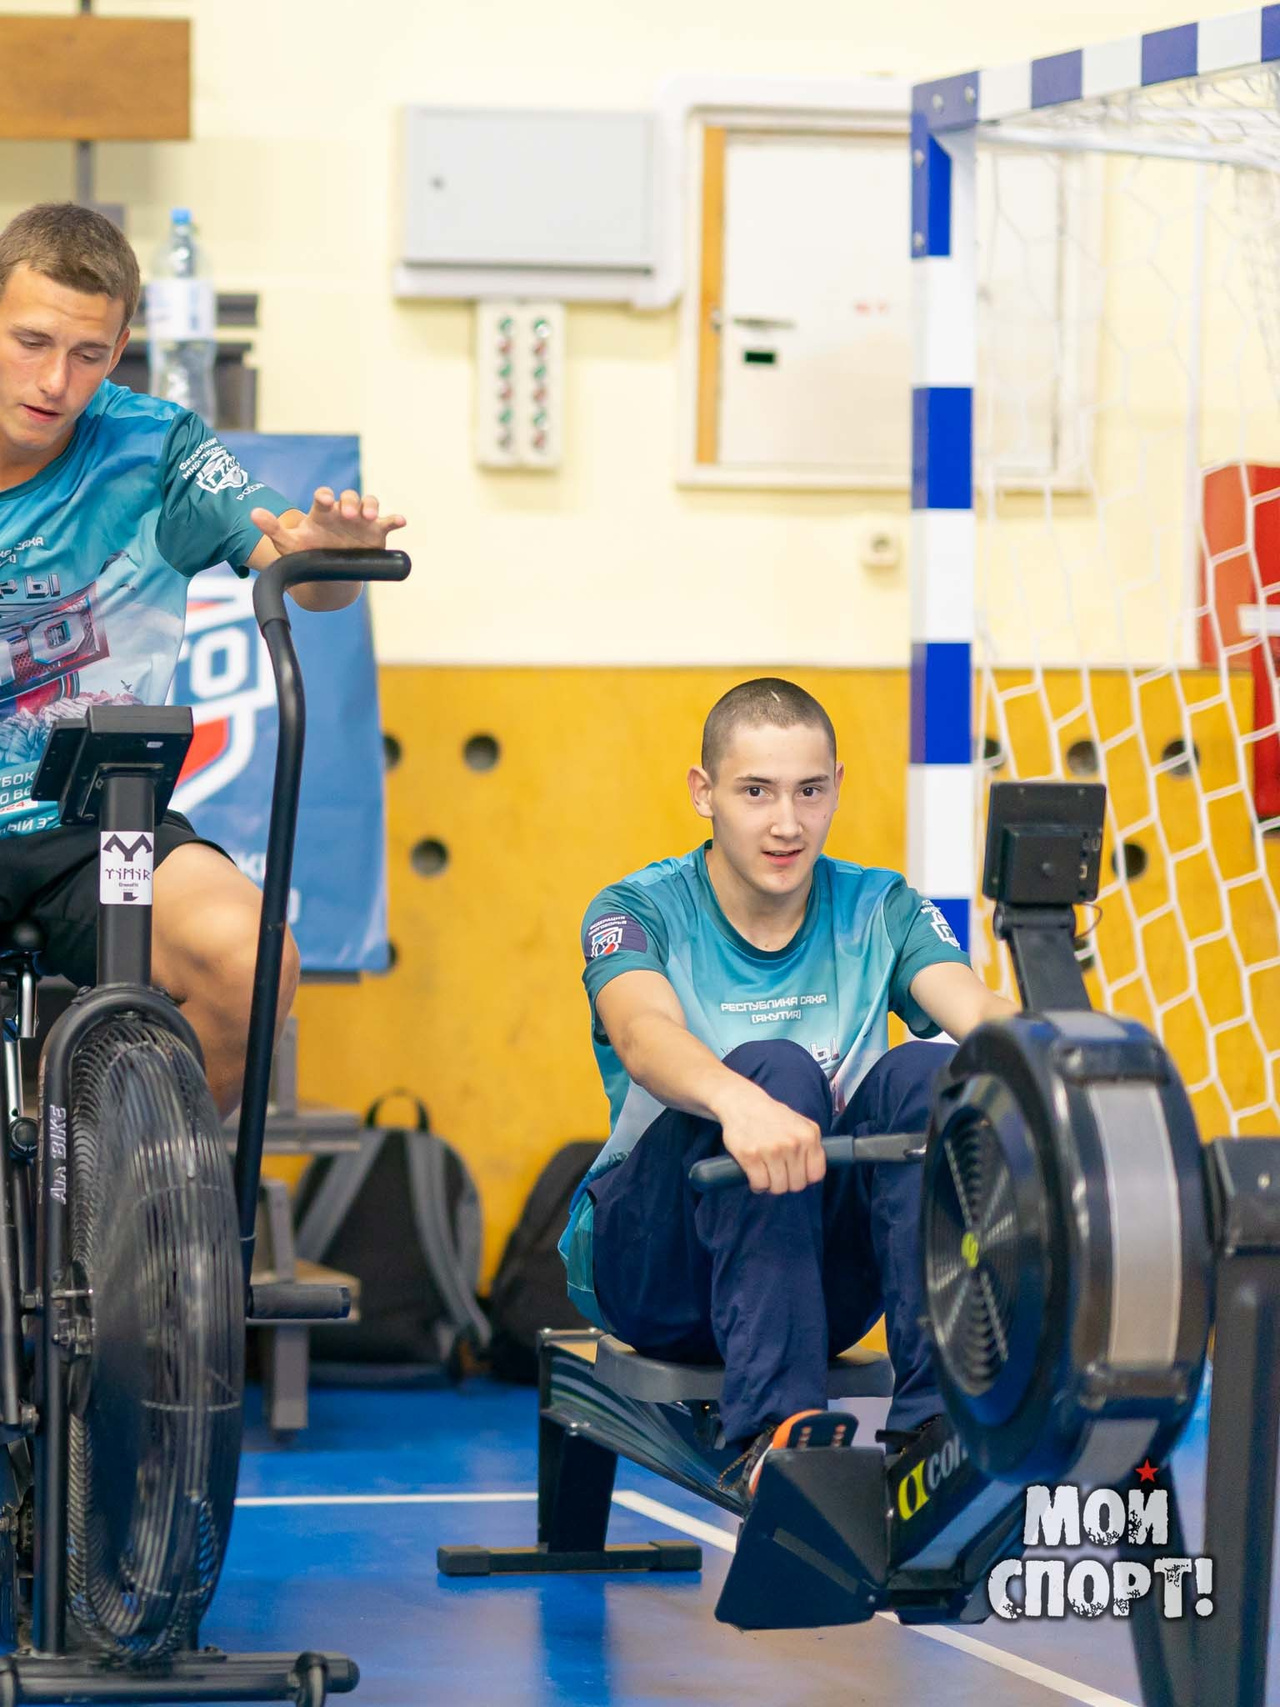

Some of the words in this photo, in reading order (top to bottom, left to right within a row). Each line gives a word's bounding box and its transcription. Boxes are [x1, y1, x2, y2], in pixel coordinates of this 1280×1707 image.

[721, 997, 798, 1012] РЕСПУБЛИКА
[800, 994, 828, 1005] САХА
[50, 1104, 67, 1160] BIKE
